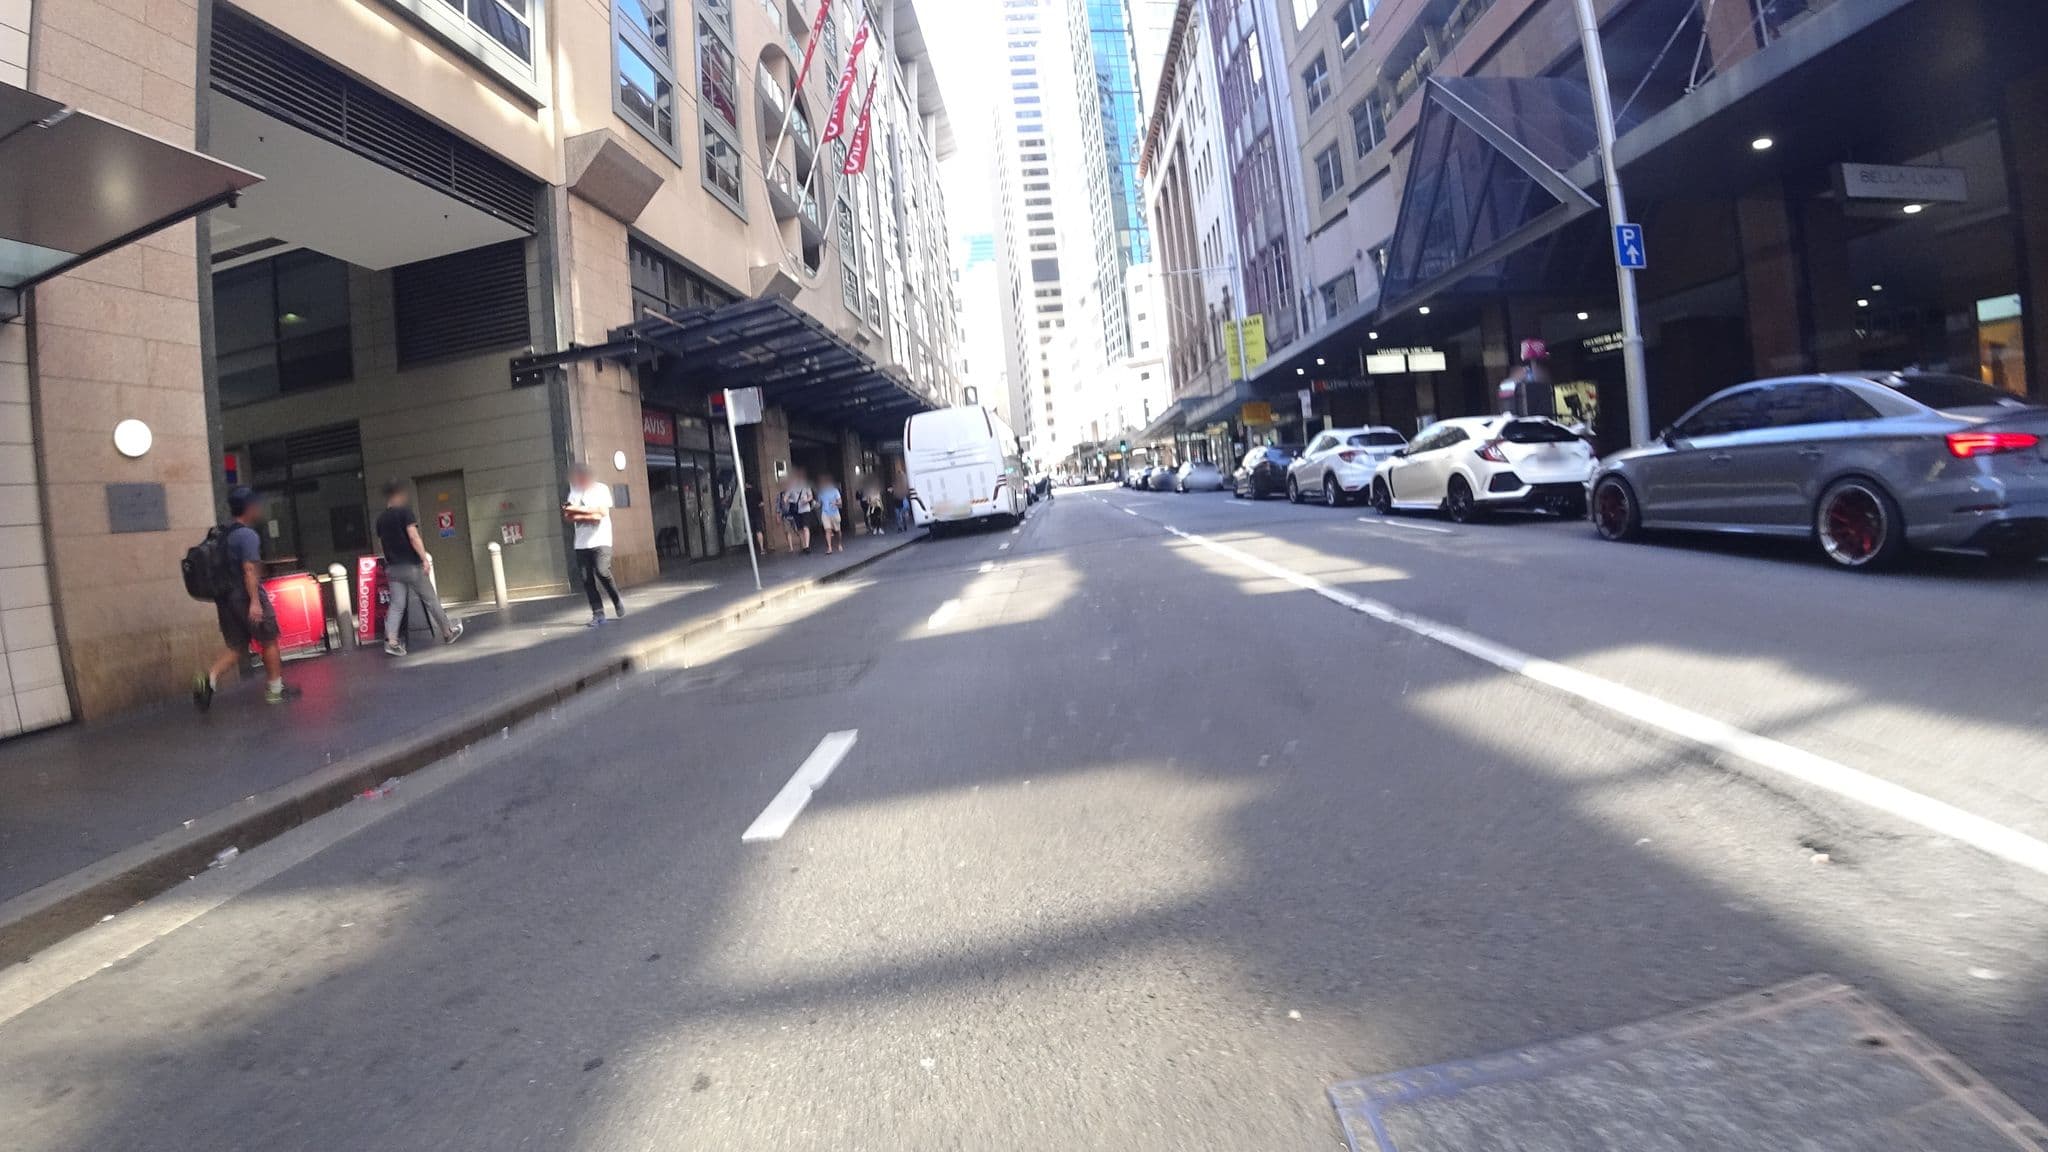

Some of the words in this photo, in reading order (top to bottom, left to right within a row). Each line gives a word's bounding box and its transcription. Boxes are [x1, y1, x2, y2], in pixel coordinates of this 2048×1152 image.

[1622, 228, 1635, 247] P
[644, 415, 666, 436] AVIS
[359, 576, 373, 634] Lorenzo
